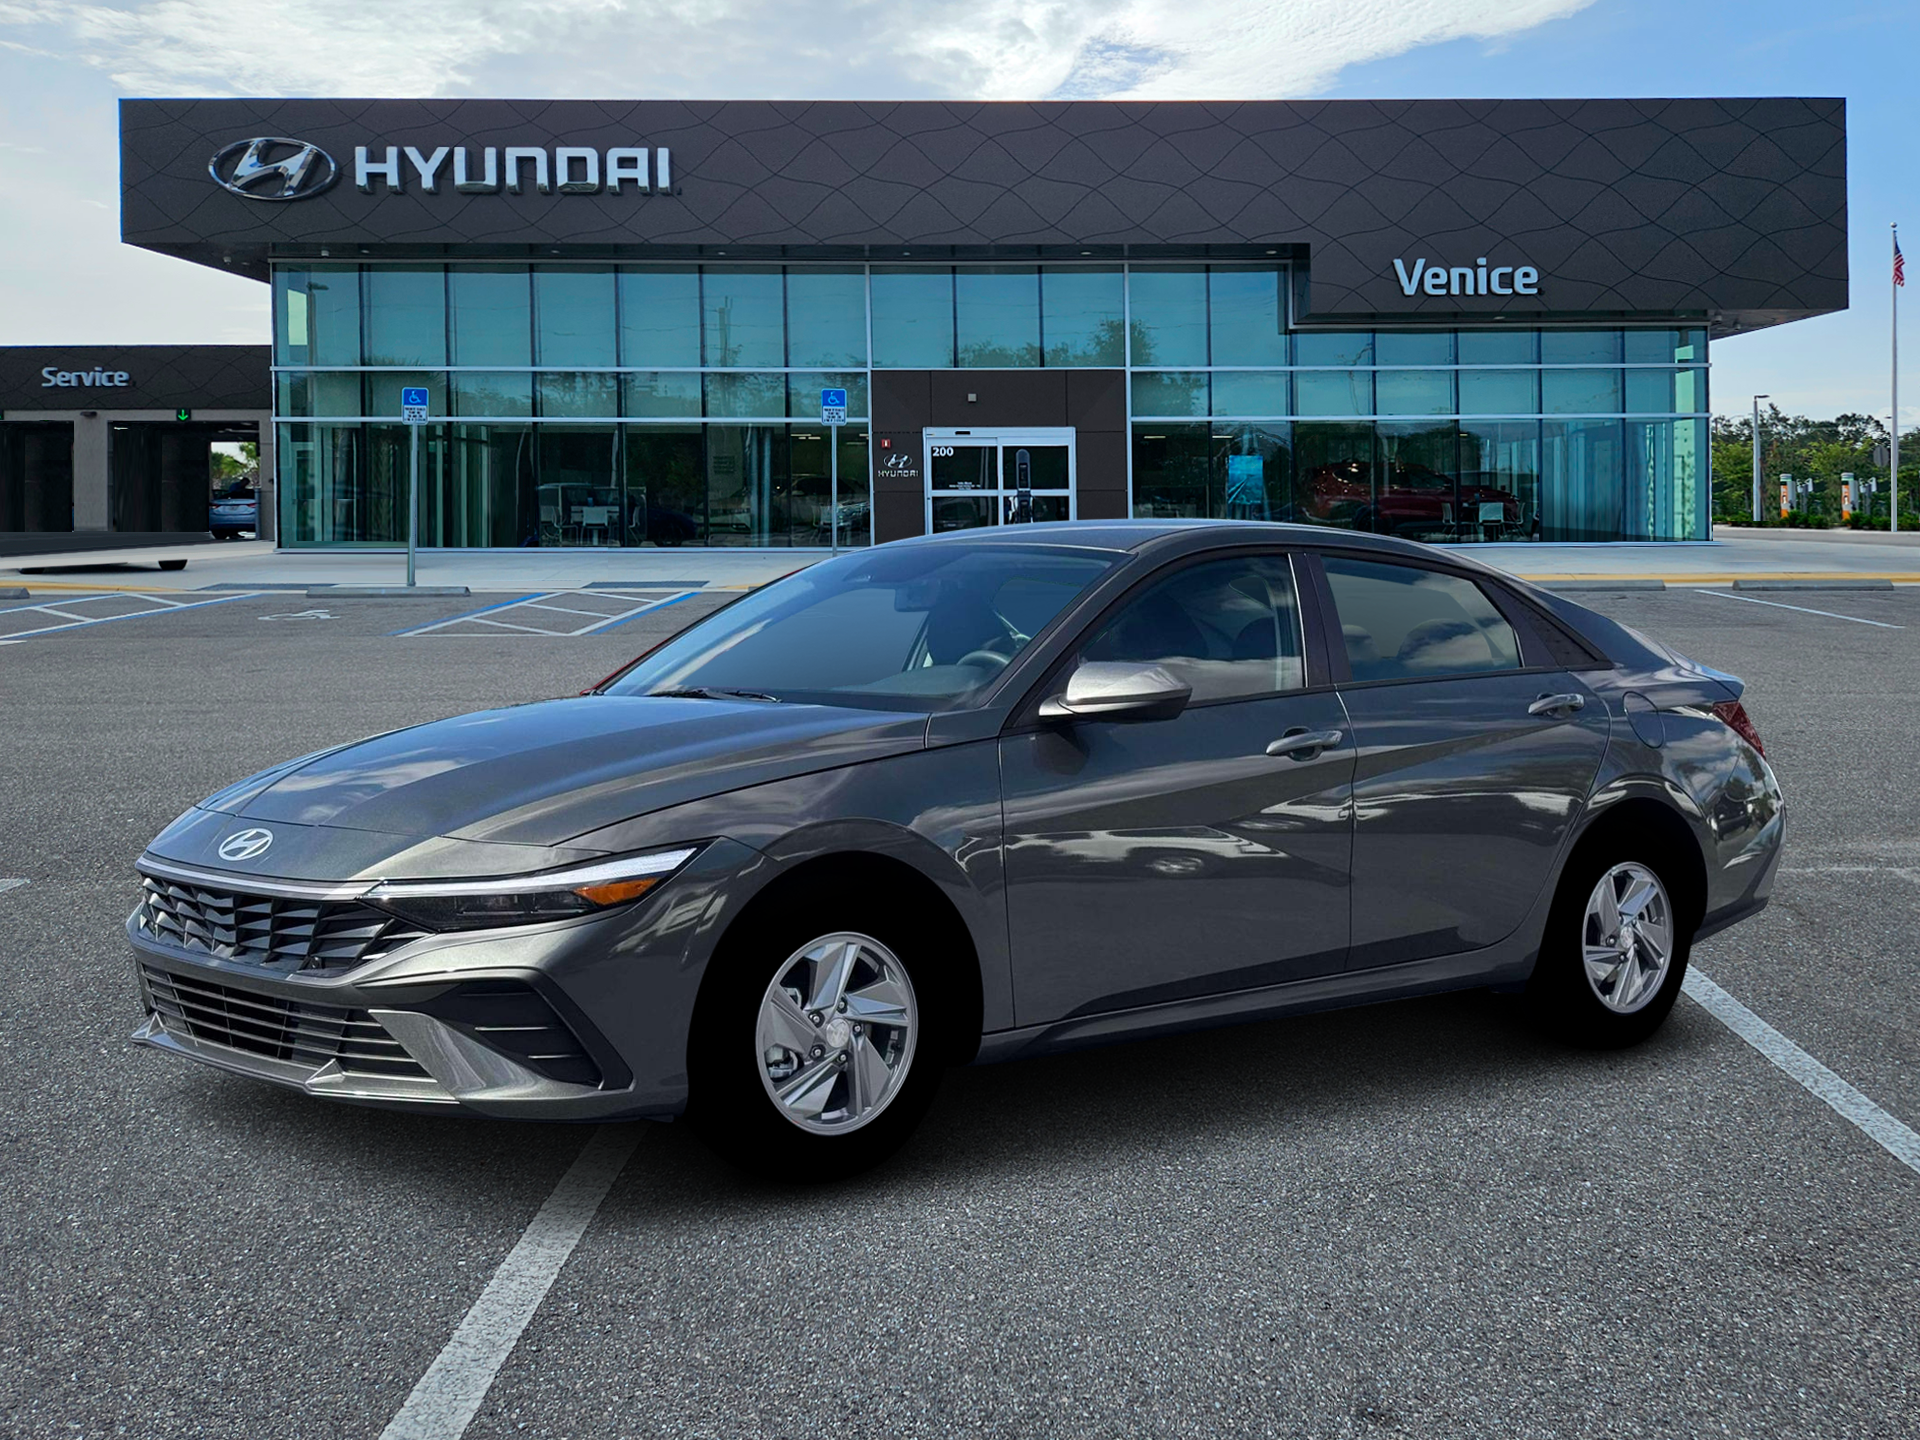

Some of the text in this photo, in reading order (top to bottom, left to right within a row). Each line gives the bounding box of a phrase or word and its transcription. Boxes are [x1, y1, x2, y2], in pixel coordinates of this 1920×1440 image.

[354, 146, 670, 194] HYUNDAI
[1393, 257, 1539, 295] Venice
[41, 366, 130, 387] Service
[932, 446, 954, 457] 200
[877, 469, 919, 478] HYUNDAI
